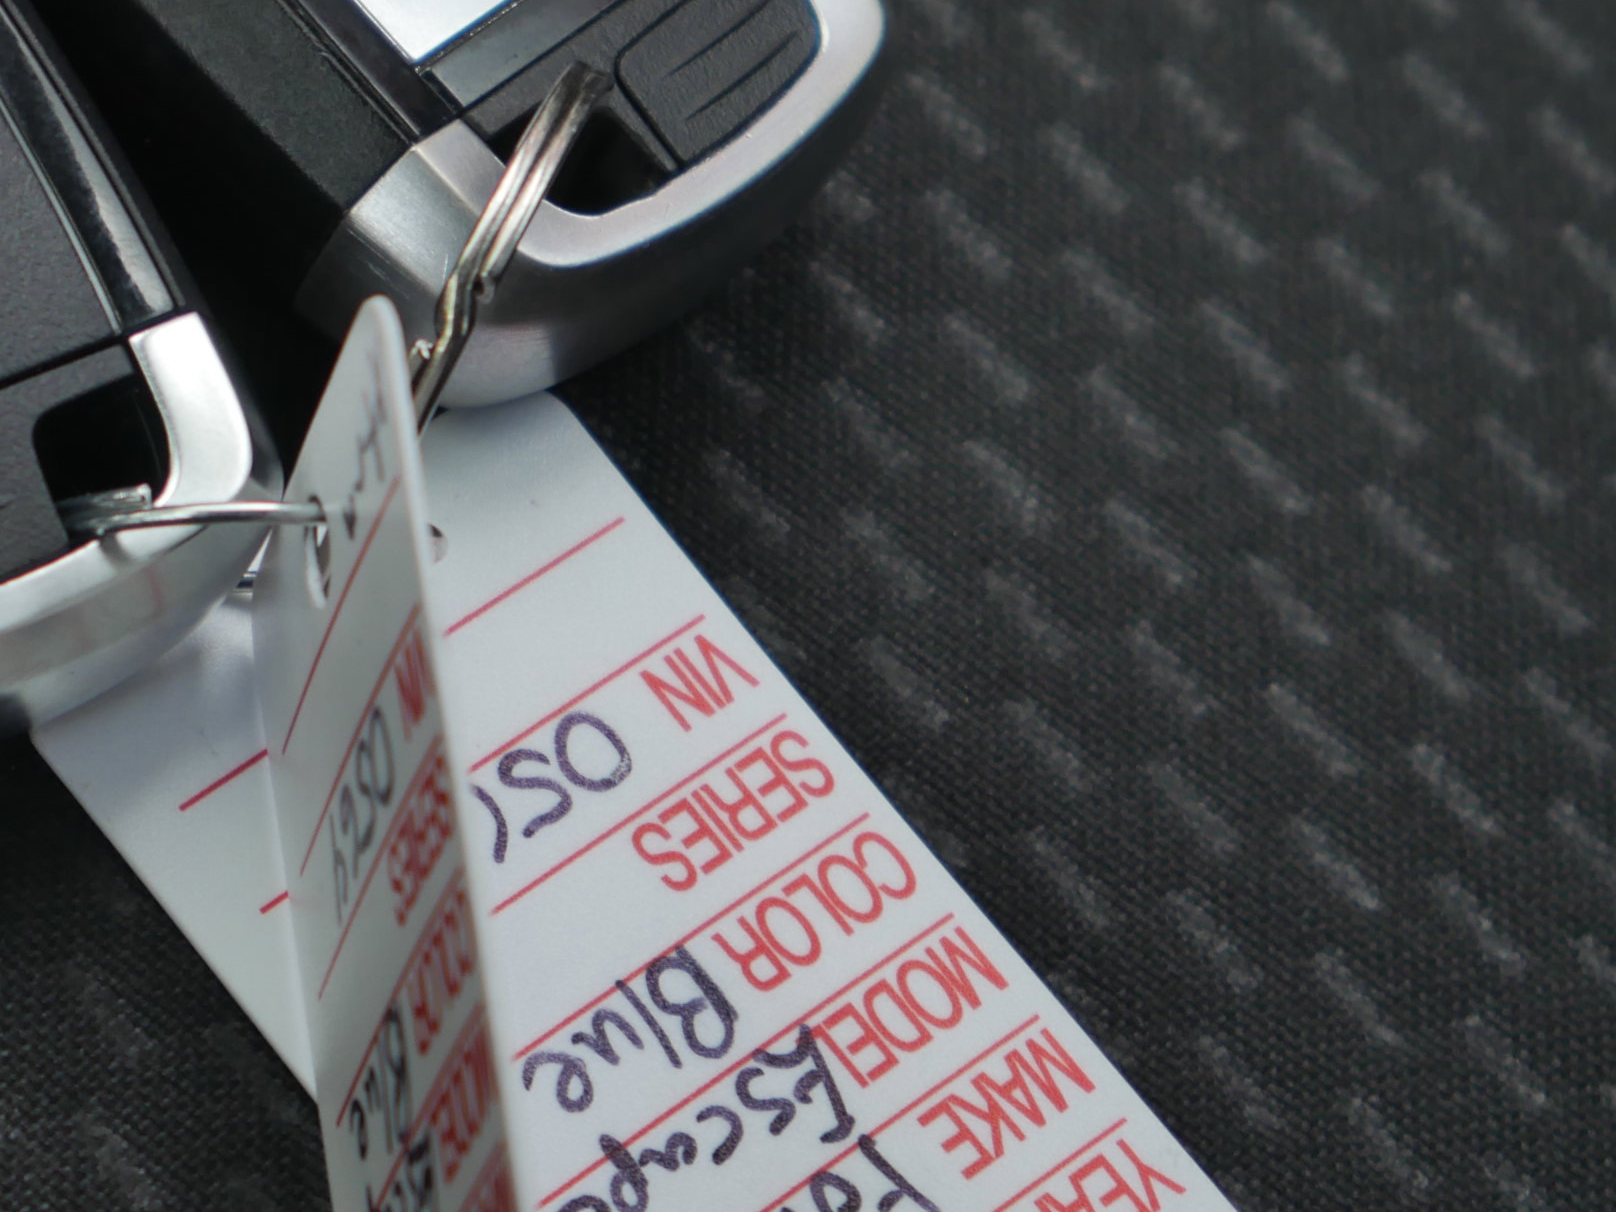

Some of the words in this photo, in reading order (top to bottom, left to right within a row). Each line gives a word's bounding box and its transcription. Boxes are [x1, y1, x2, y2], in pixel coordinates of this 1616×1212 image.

[640, 633, 760, 732] VIN
[631, 729, 835, 892] SERIES
[713, 830, 918, 993] COLOR
[523, 944, 738, 1113] Blue
[917, 1027, 1096, 1181] MAKE
